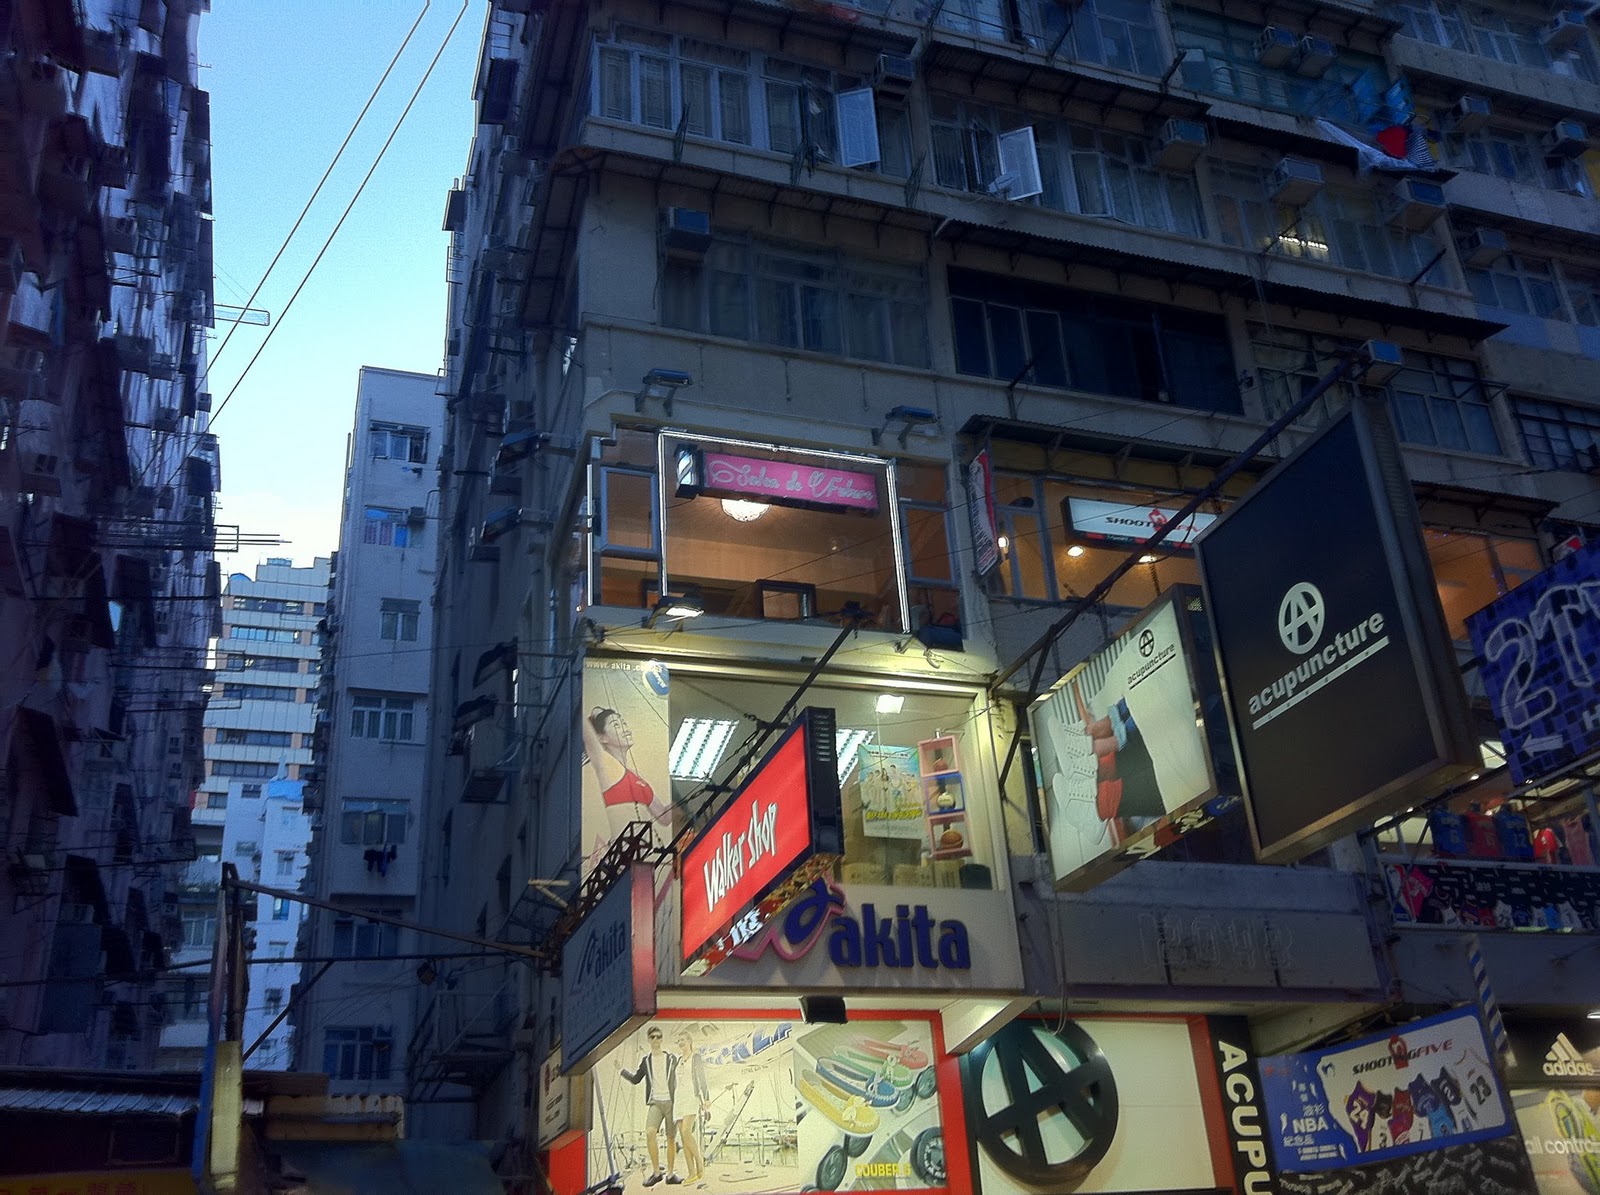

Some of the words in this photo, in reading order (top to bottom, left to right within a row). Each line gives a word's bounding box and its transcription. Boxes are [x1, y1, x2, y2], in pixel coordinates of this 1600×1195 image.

[1127, 643, 1175, 685] acupuncture
[1249, 612, 1385, 716] acupuncture
[703, 831, 747, 914] Walker
[1542, 1060, 1595, 1076] adidas
[1292, 1117, 1329, 1134] NBA
